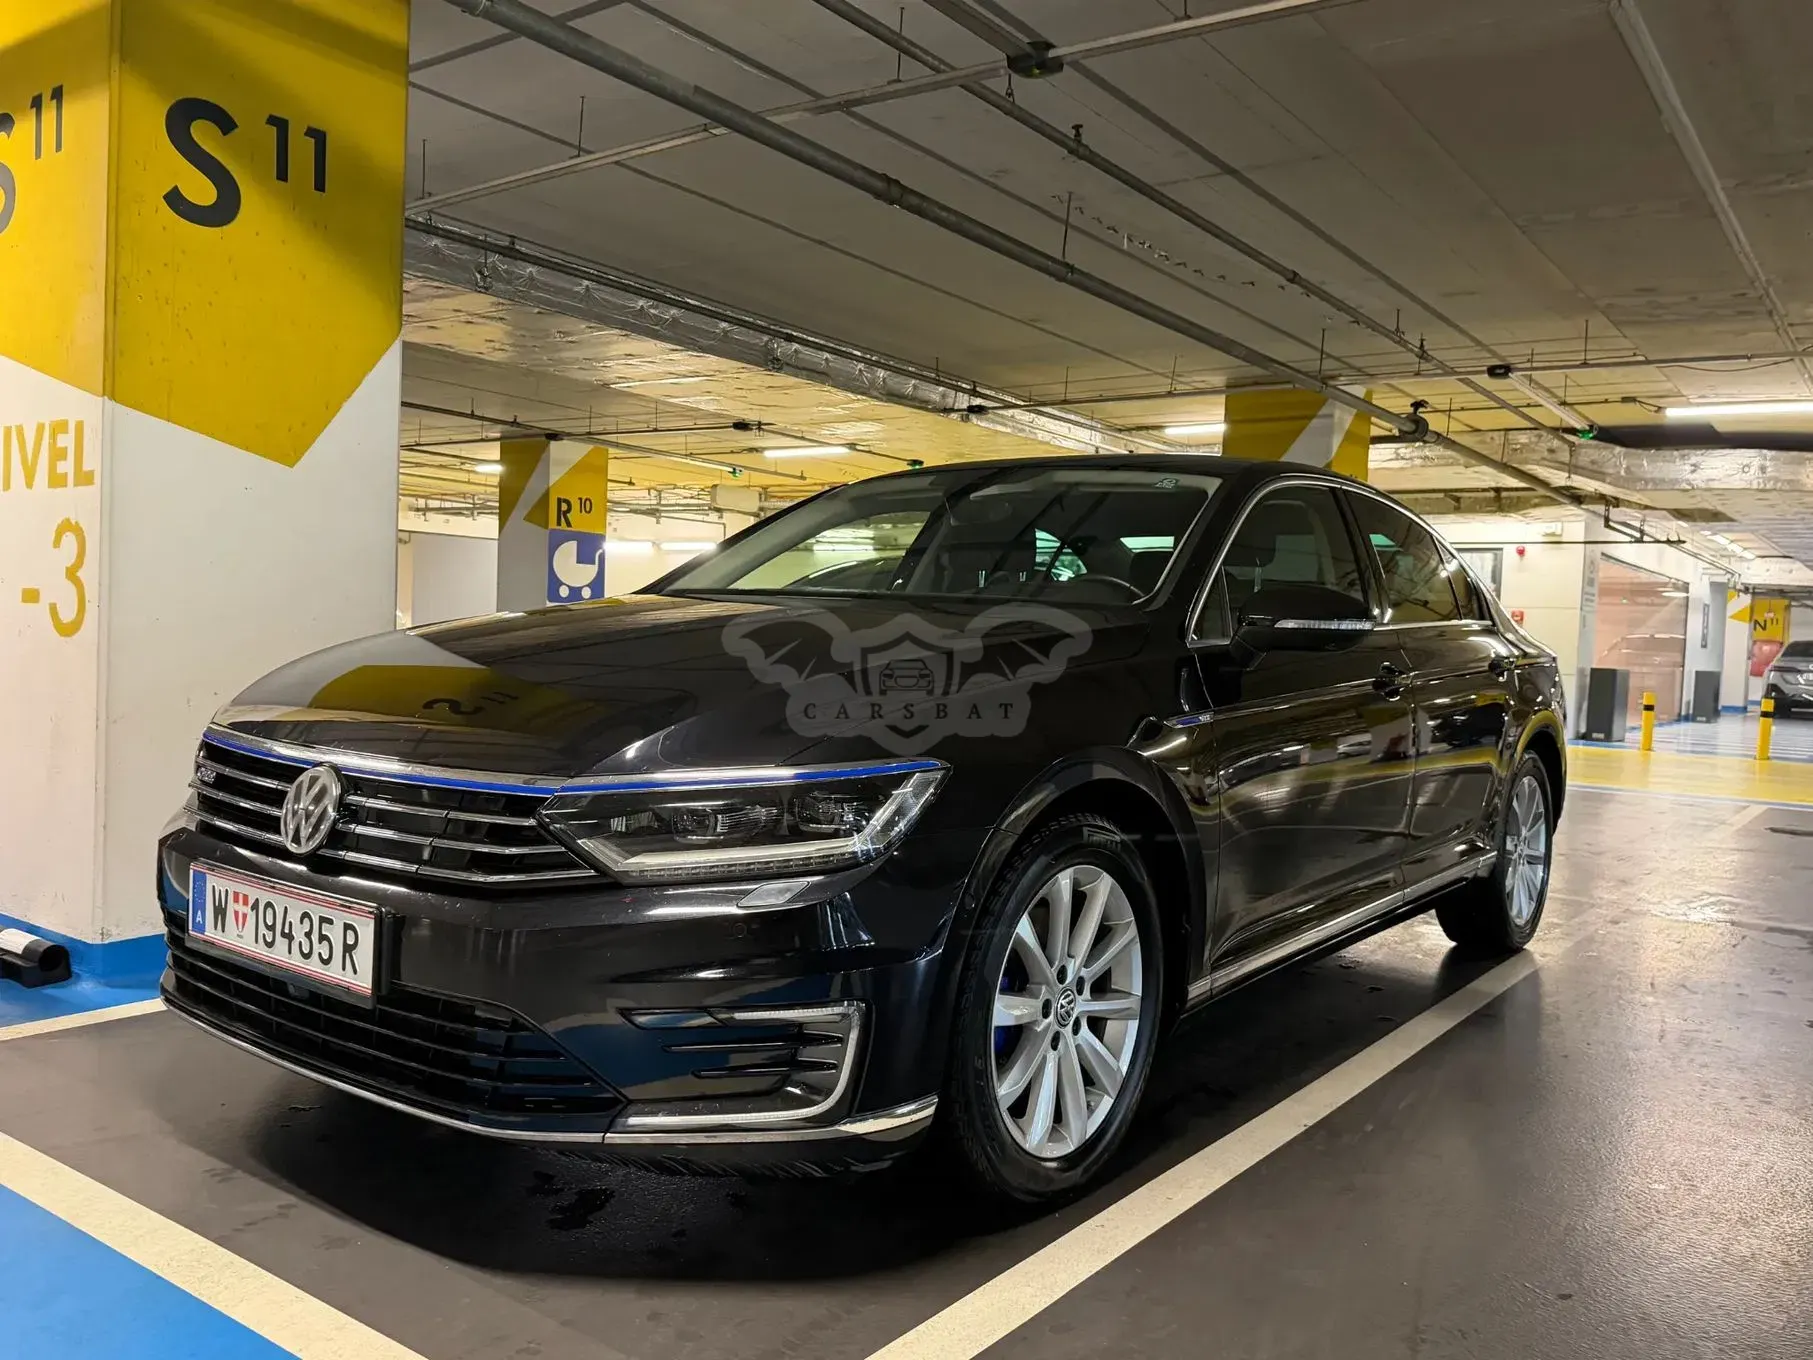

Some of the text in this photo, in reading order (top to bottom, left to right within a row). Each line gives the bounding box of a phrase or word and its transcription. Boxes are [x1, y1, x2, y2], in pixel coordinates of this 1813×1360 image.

[30, 84, 63, 160] 11
[162, 97, 327, 228] S 11
[2, 418, 95, 491] IVEL
[556, 496, 593, 528] R 10
[21, 517, 86, 637] -3
[1753, 619, 1767, 632] N
[195, 910, 203, 924] A
[212, 884, 229, 933] W
